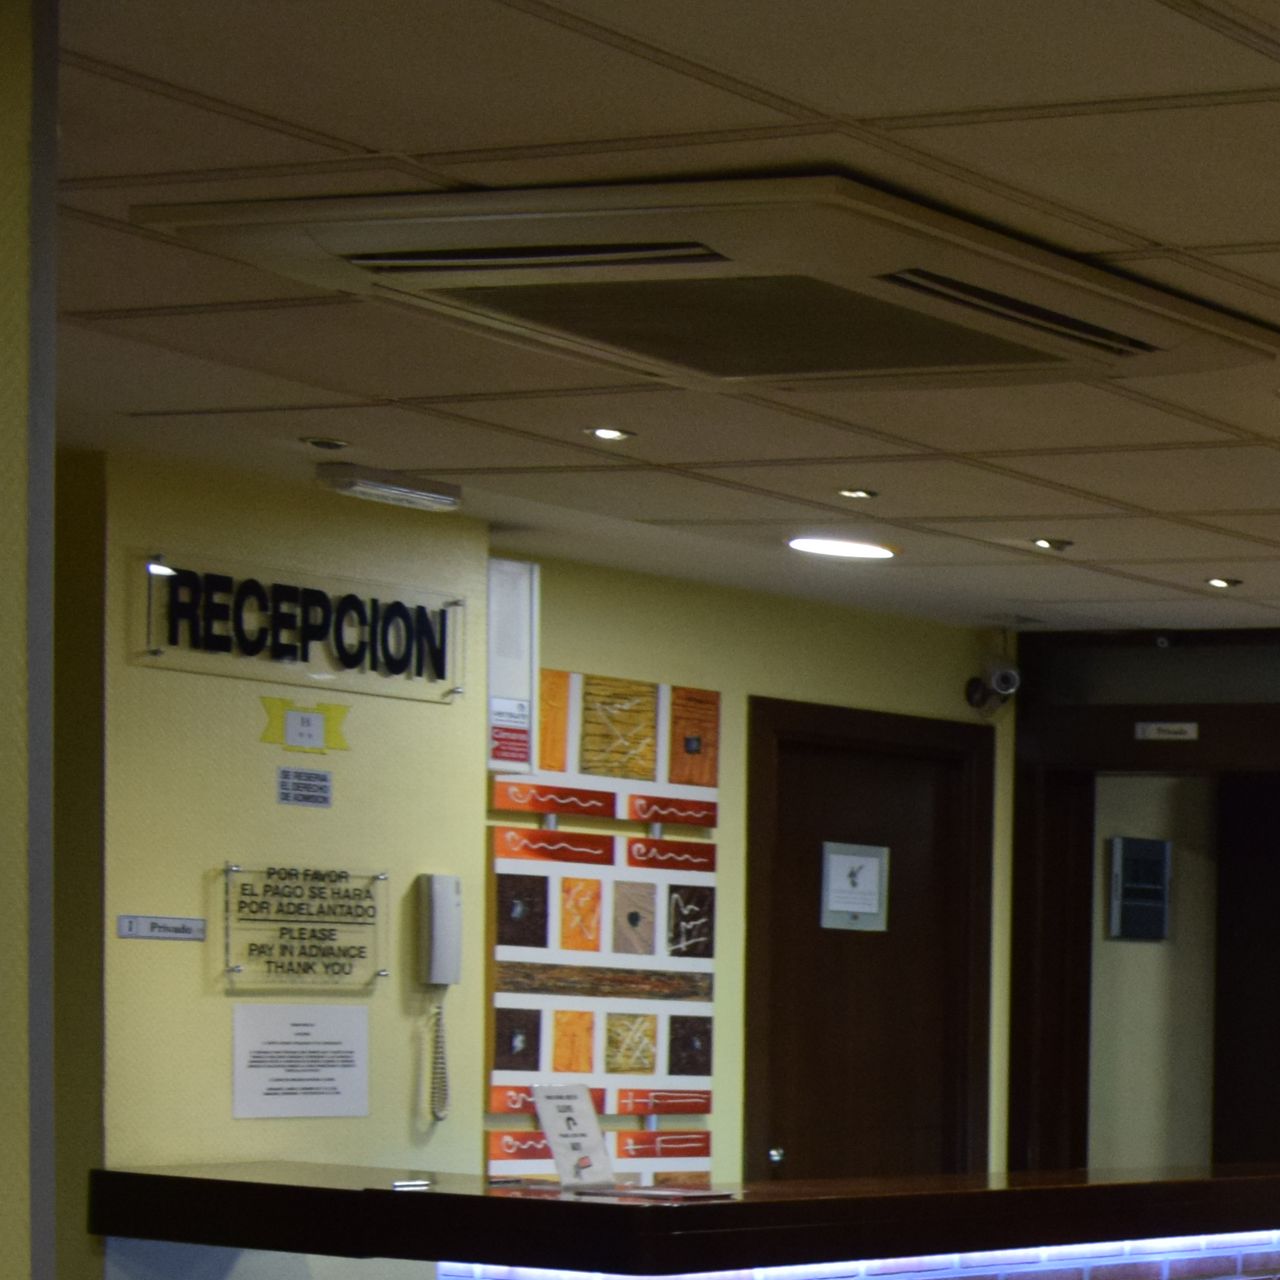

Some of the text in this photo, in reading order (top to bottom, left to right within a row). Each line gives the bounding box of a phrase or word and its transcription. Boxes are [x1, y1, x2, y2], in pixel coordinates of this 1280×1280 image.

[166, 566, 447, 680] RECEPCION
[266, 867, 350, 883] POR FAVOR
[240, 883, 258, 897] EL
[263, 884, 304, 898] PAGO
[308, 886, 327, 900] SE
[238, 900, 376, 918] POR ADELANTADO
[280, 927, 337, 941] PLEASE
[248, 943, 367, 959] PAY IN ADVANCE
[266, 960, 353, 975] THANK YOU
